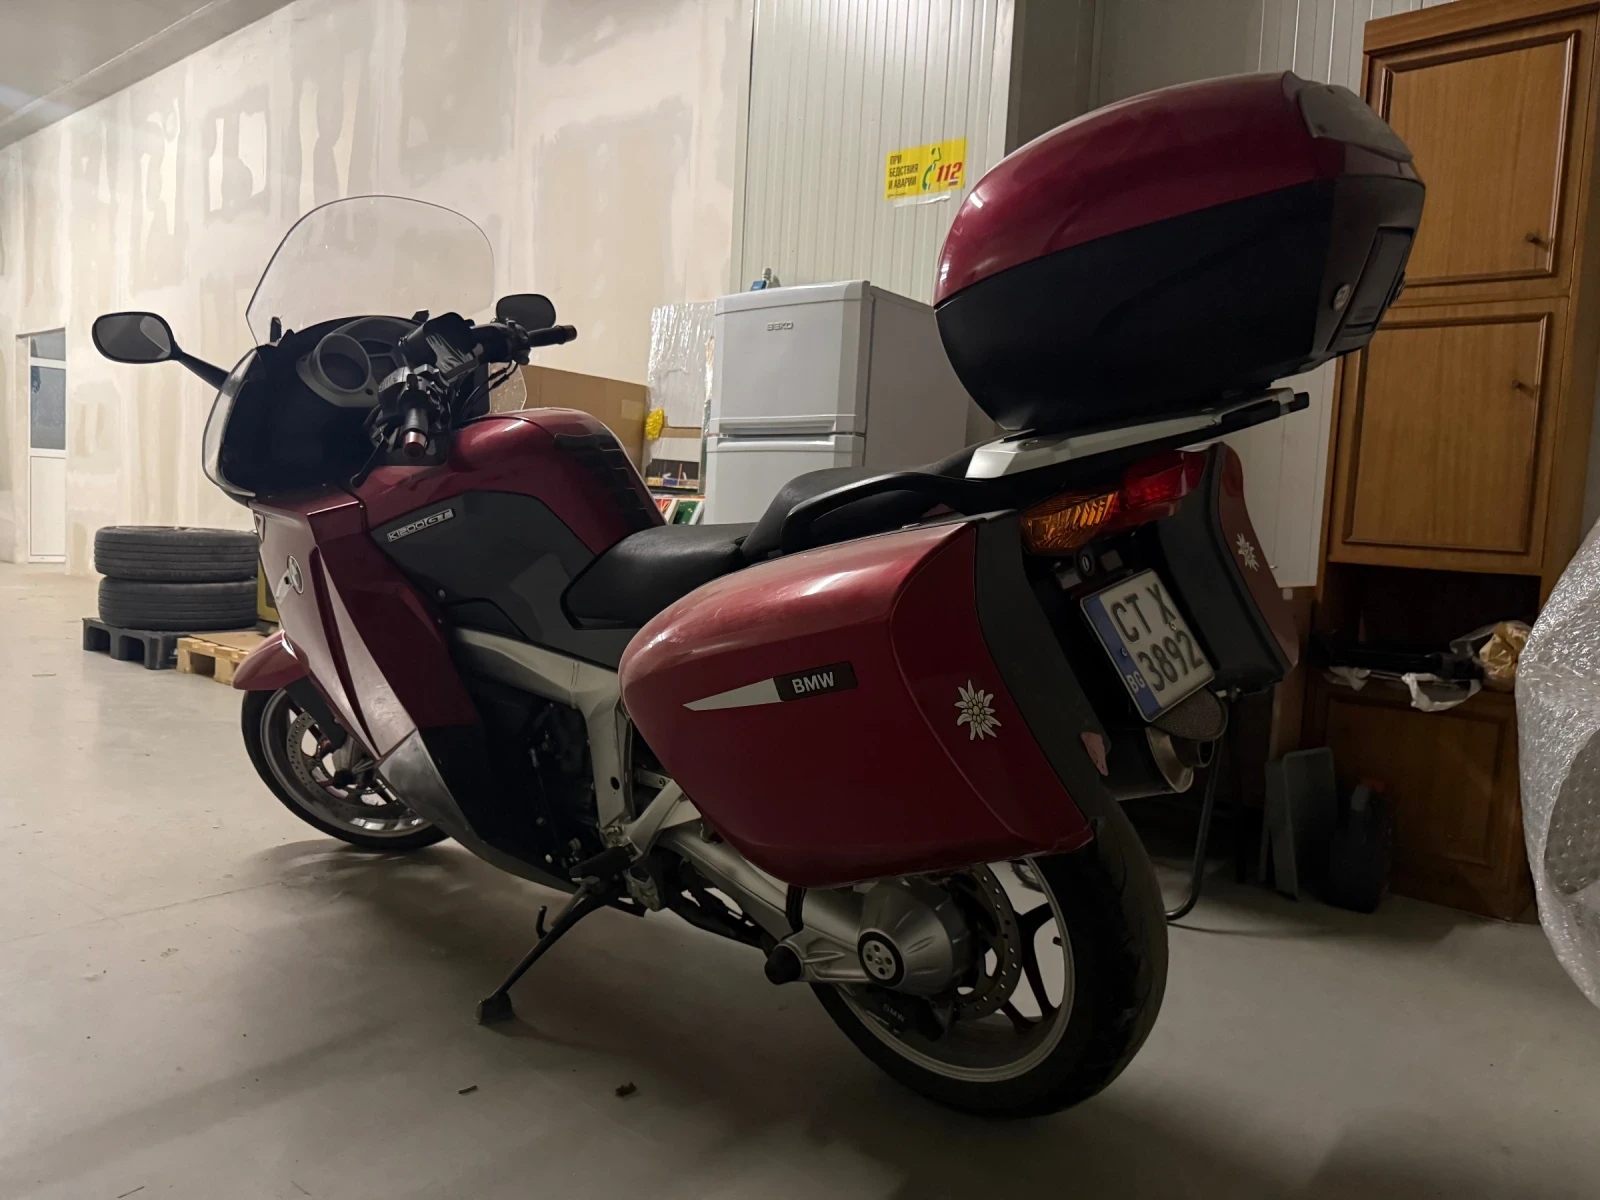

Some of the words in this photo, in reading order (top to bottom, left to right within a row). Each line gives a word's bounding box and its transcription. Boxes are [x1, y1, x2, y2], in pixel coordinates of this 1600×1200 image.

[890, 155, 902, 165] ПРИ
[889, 164, 918, 177] БЕДСТВИЯ
[936, 162, 963, 182] 112
[894, 176, 917, 189] АВАРИИ
[767, 321, 794, 332] BEKO
[1111, 593, 1152, 642] CT
[1145, 583, 1176, 624] X
[1137, 630, 1204, 691] 3892
[791, 671, 835, 694] BMW
[1126, 671, 1146, 694] BG
